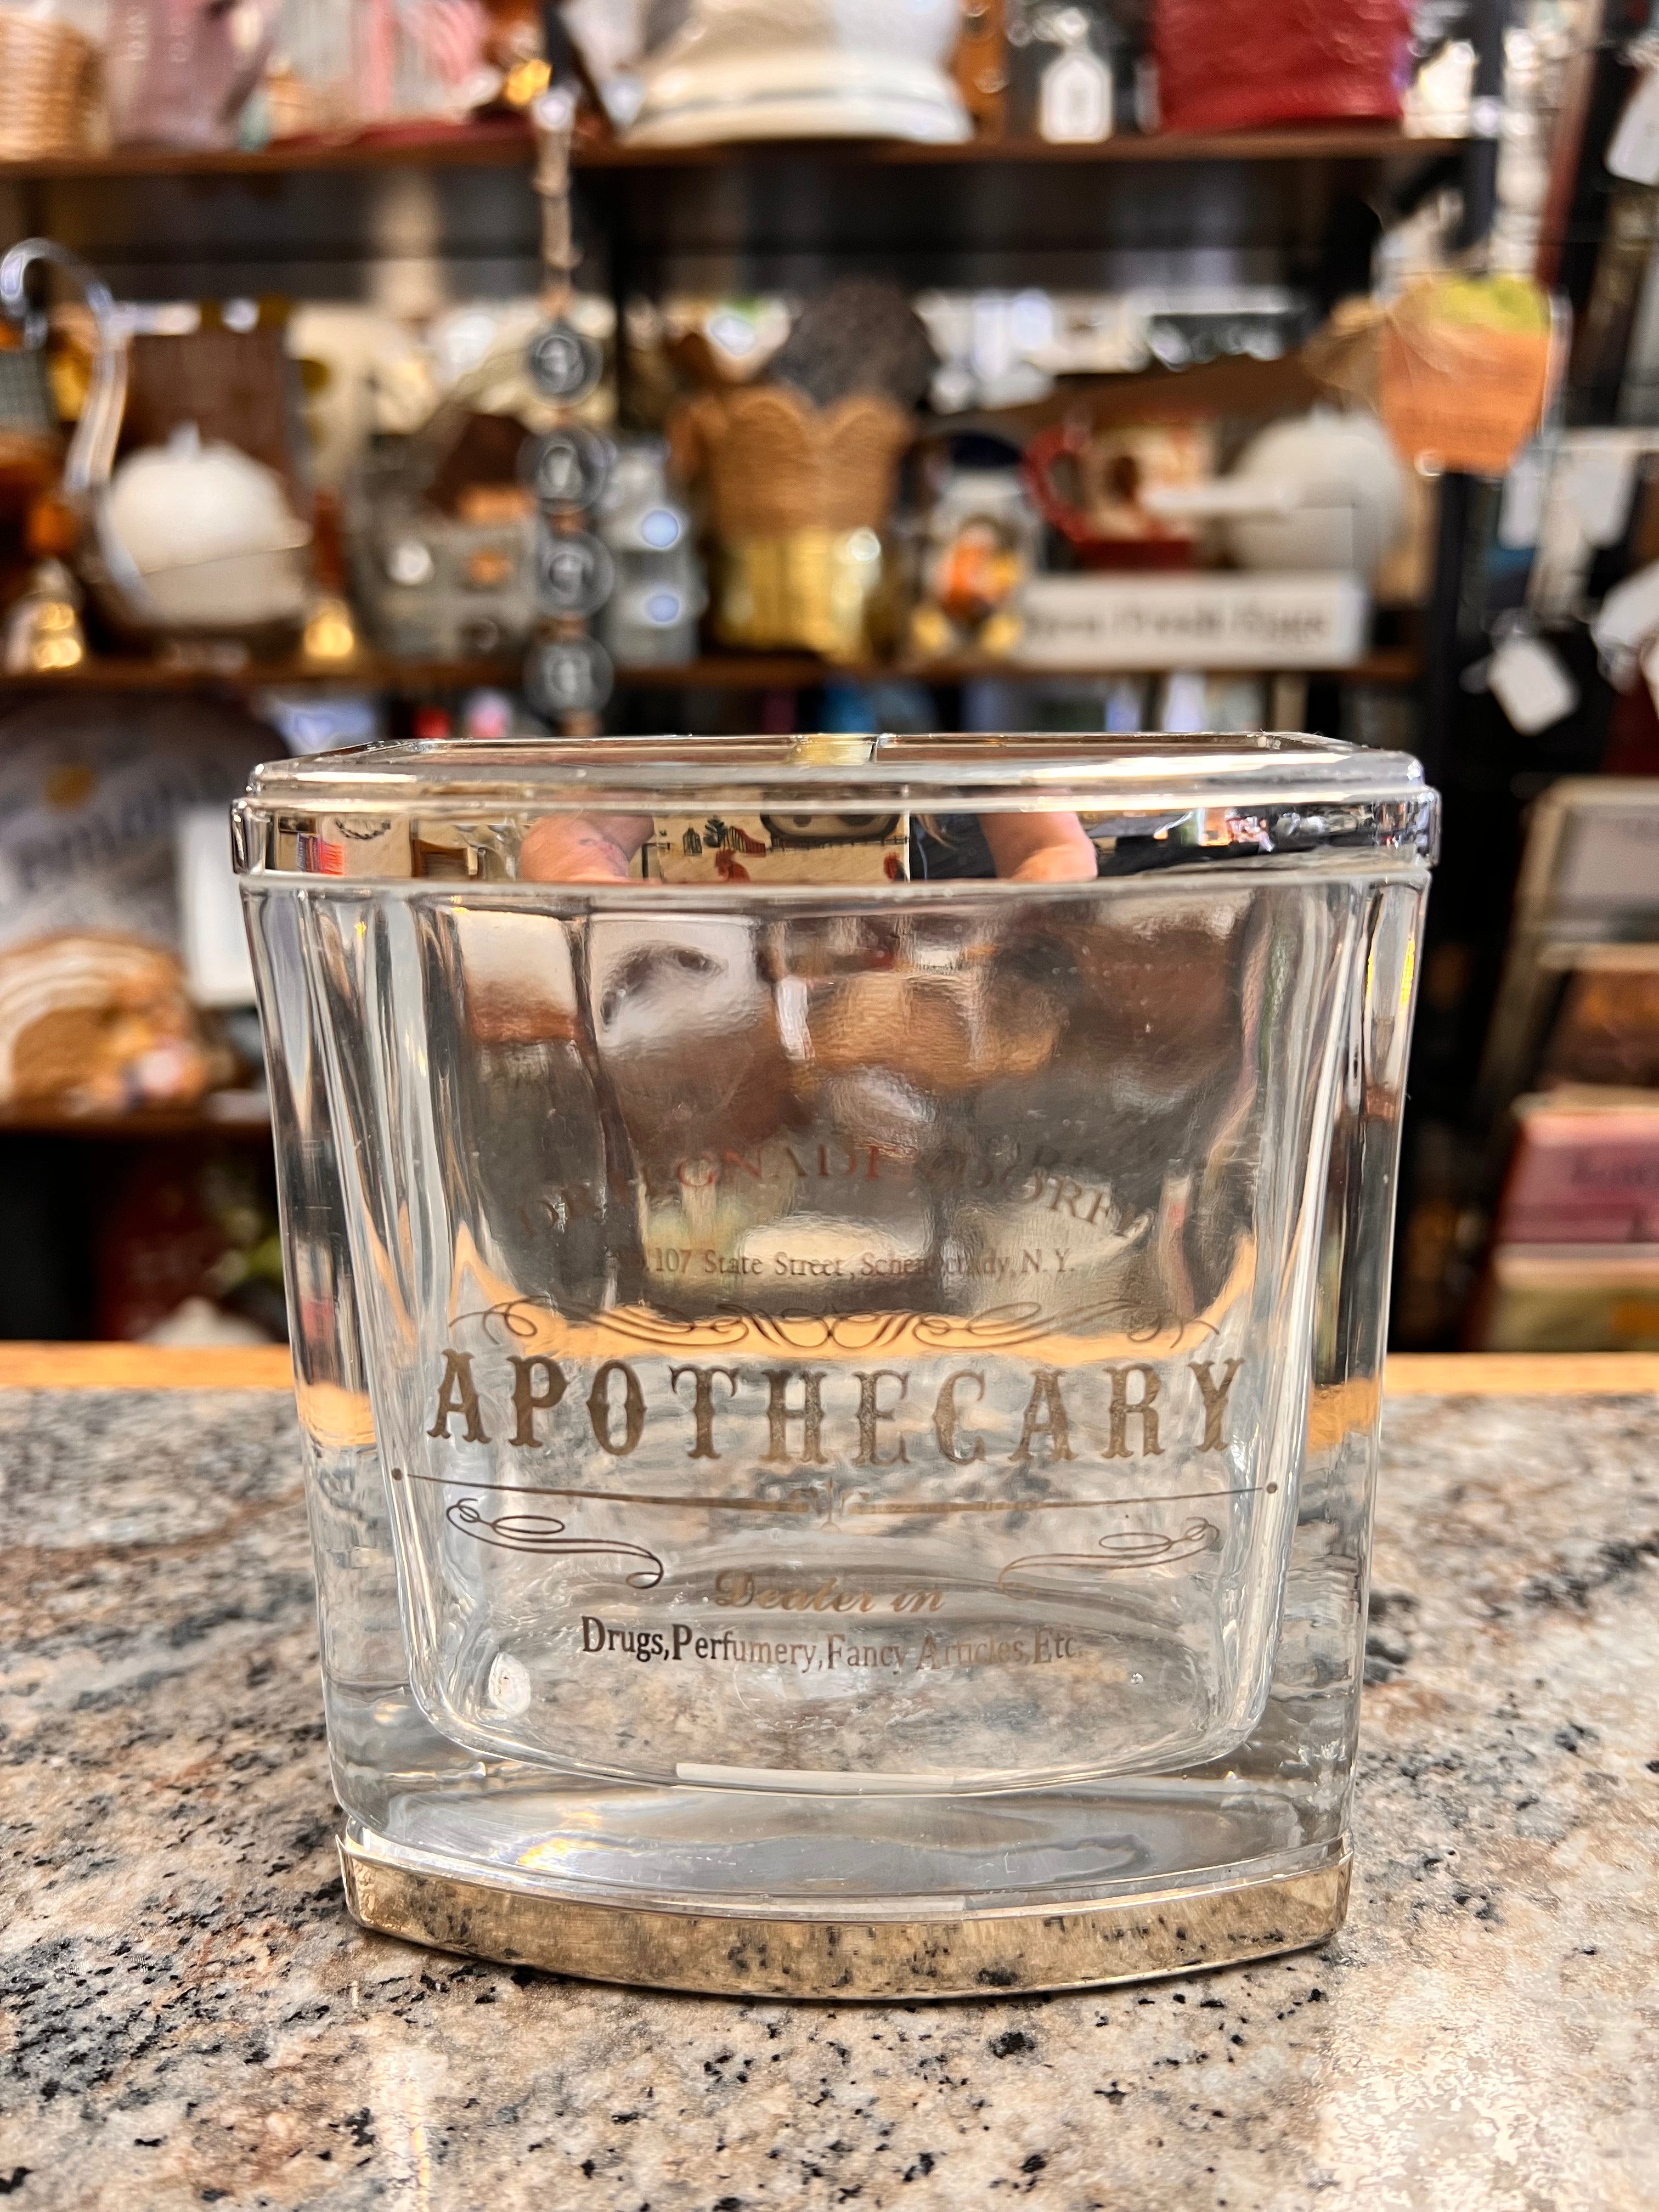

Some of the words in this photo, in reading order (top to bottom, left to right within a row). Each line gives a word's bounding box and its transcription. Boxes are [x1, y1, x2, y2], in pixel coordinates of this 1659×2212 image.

[655, 1247, 693, 1274] 107
[704, 1248, 763, 1274] State
[427, 1348, 1245, 1466] APOTHECARY
[715, 1569, 875, 1613] Dealer
[890, 1589, 946, 1613] in
[827, 1633, 907, 1675] Fancy
